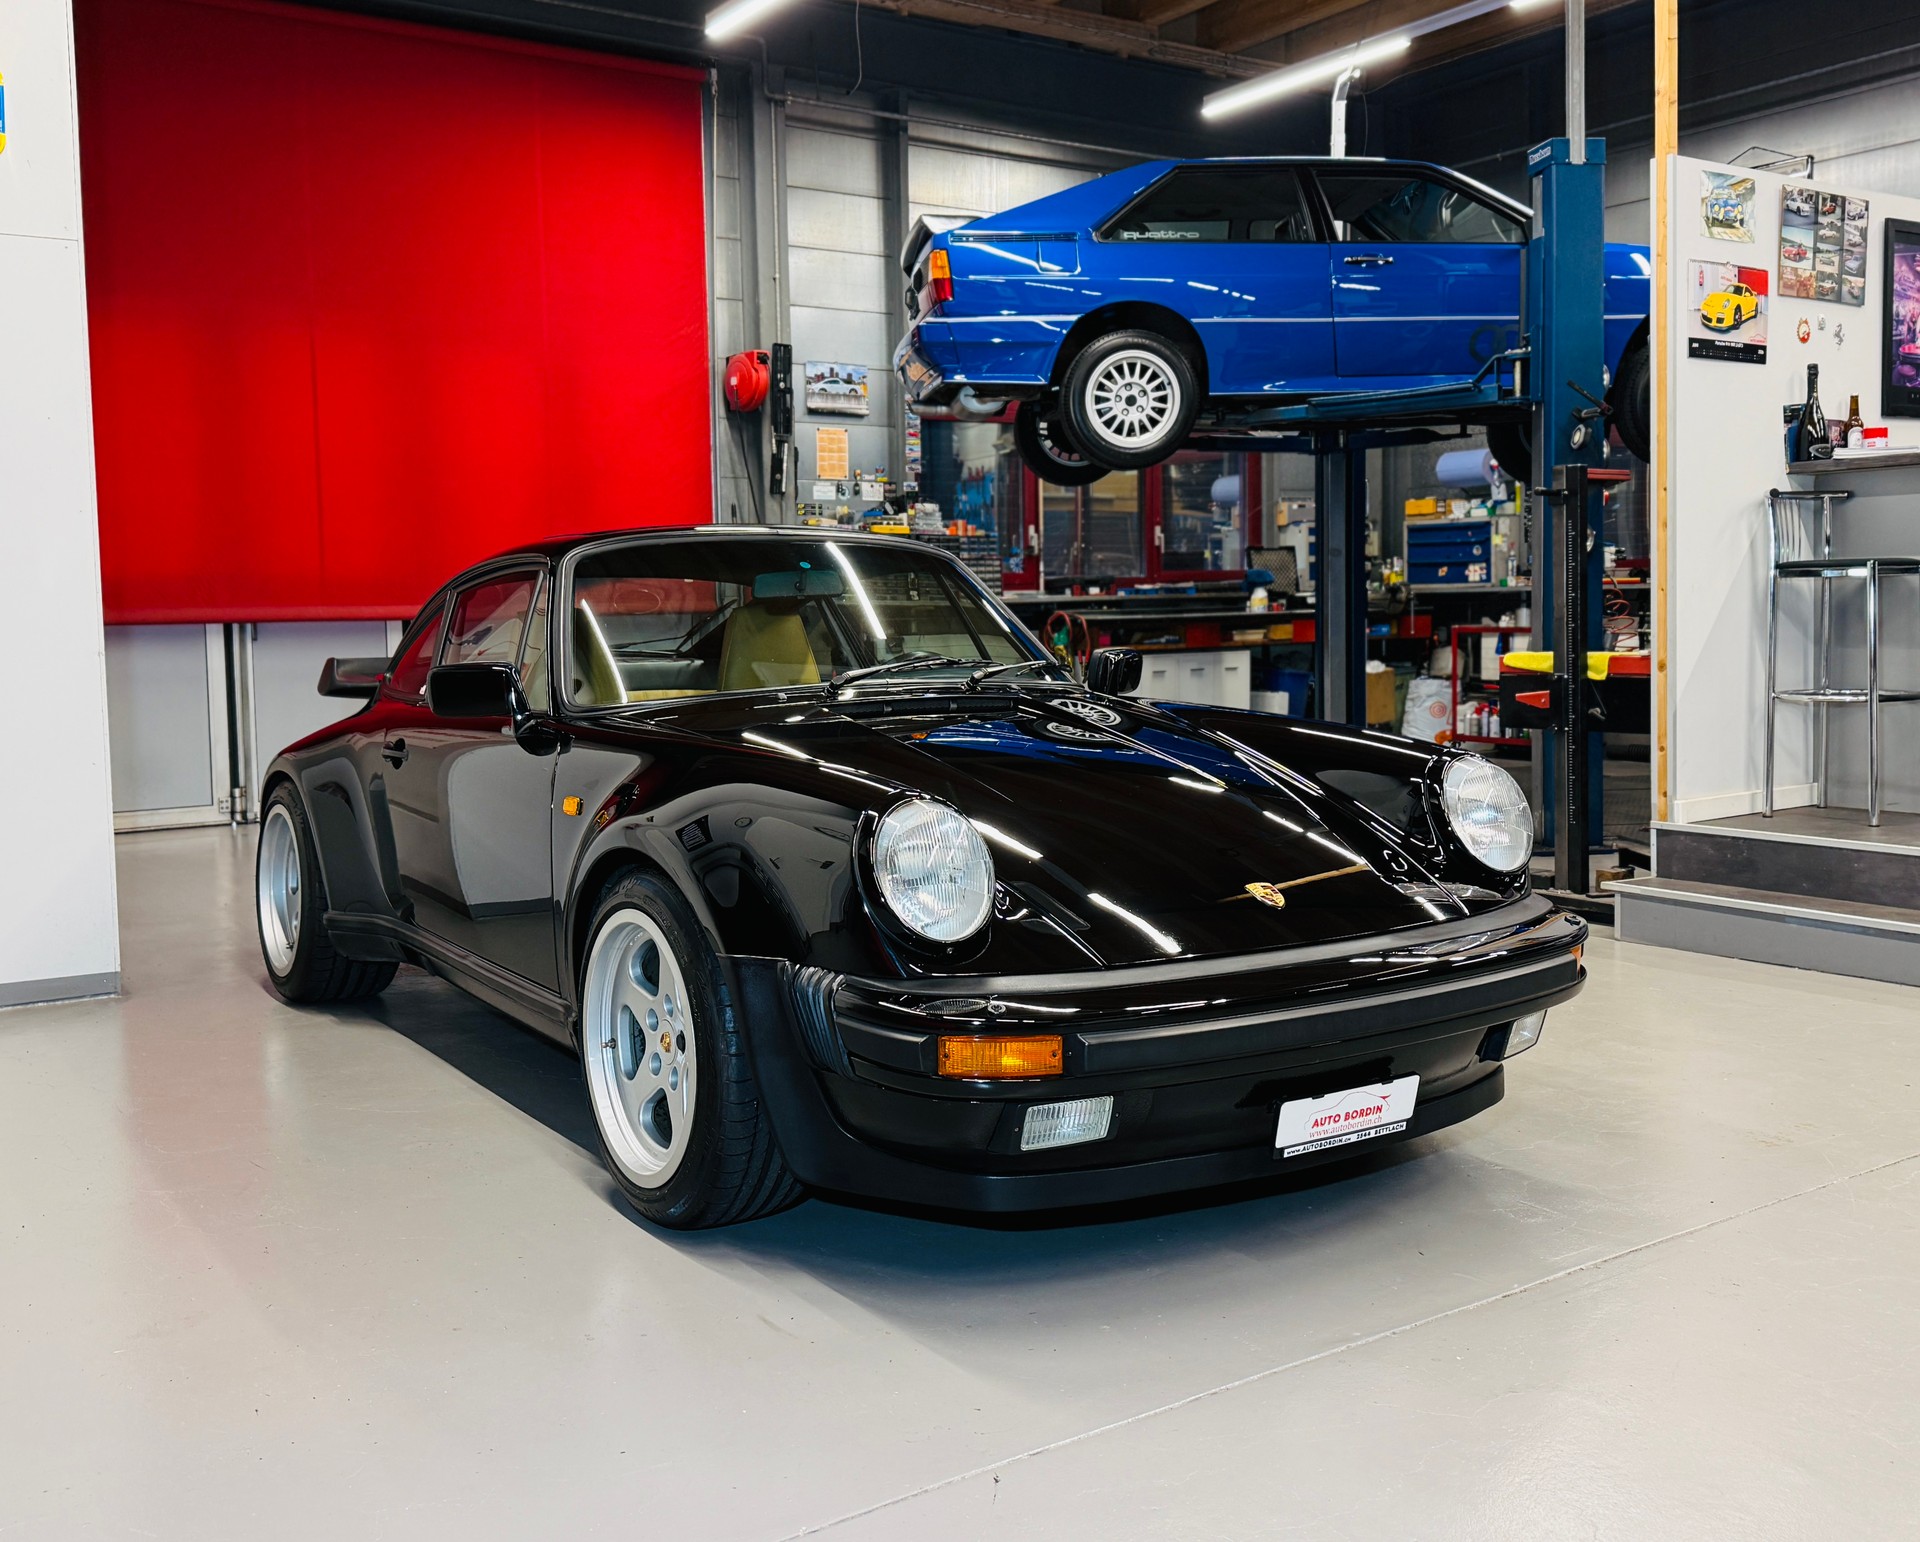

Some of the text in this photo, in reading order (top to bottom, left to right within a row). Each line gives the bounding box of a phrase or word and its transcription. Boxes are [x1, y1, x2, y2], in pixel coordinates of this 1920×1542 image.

[1123, 230, 1200, 240] quattro
[1311, 1104, 1383, 1129] AUTO BORDIN
[1309, 1115, 1383, 1138] www.autobordin.ch
[1374, 1123, 1405, 1136] BETTLACH
